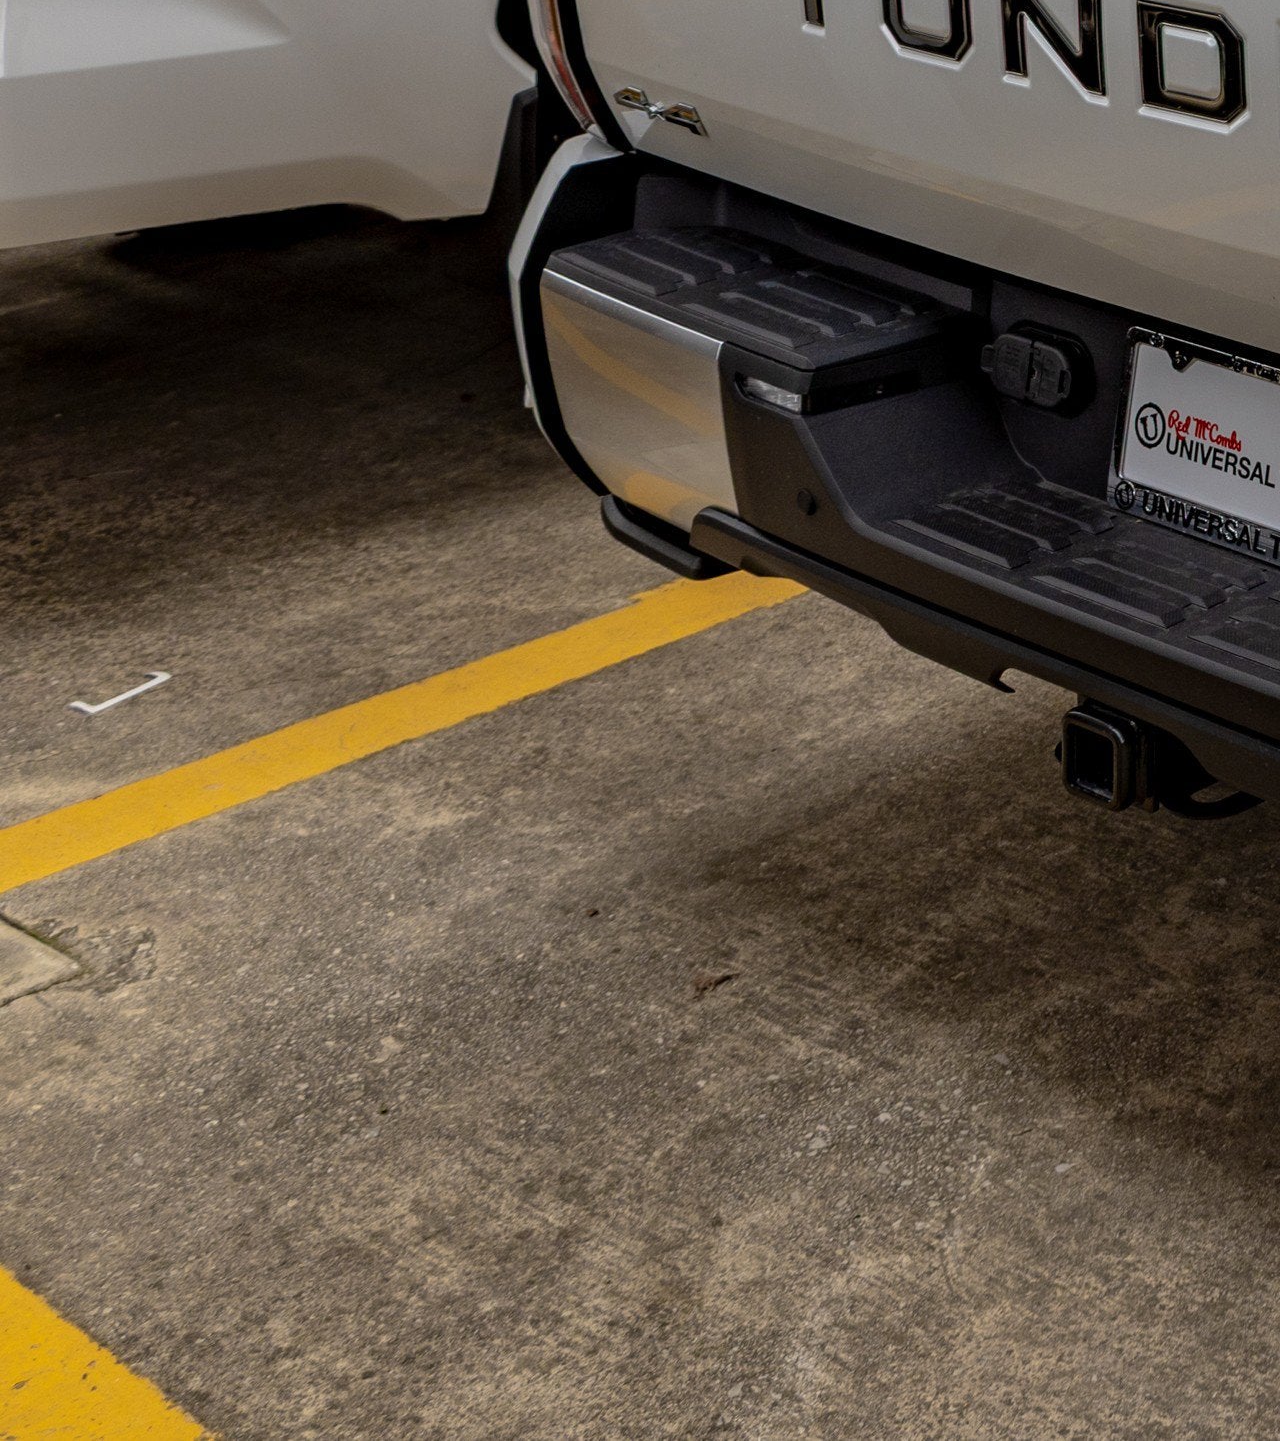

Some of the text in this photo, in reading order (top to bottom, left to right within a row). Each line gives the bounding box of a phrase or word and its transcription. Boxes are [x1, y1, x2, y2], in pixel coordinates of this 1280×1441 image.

[1167, 409, 1242, 452] Red McCombs
[1165, 431, 1276, 489] UNIVERSAL
[1141, 489, 1267, 555] UNIVERSAL
